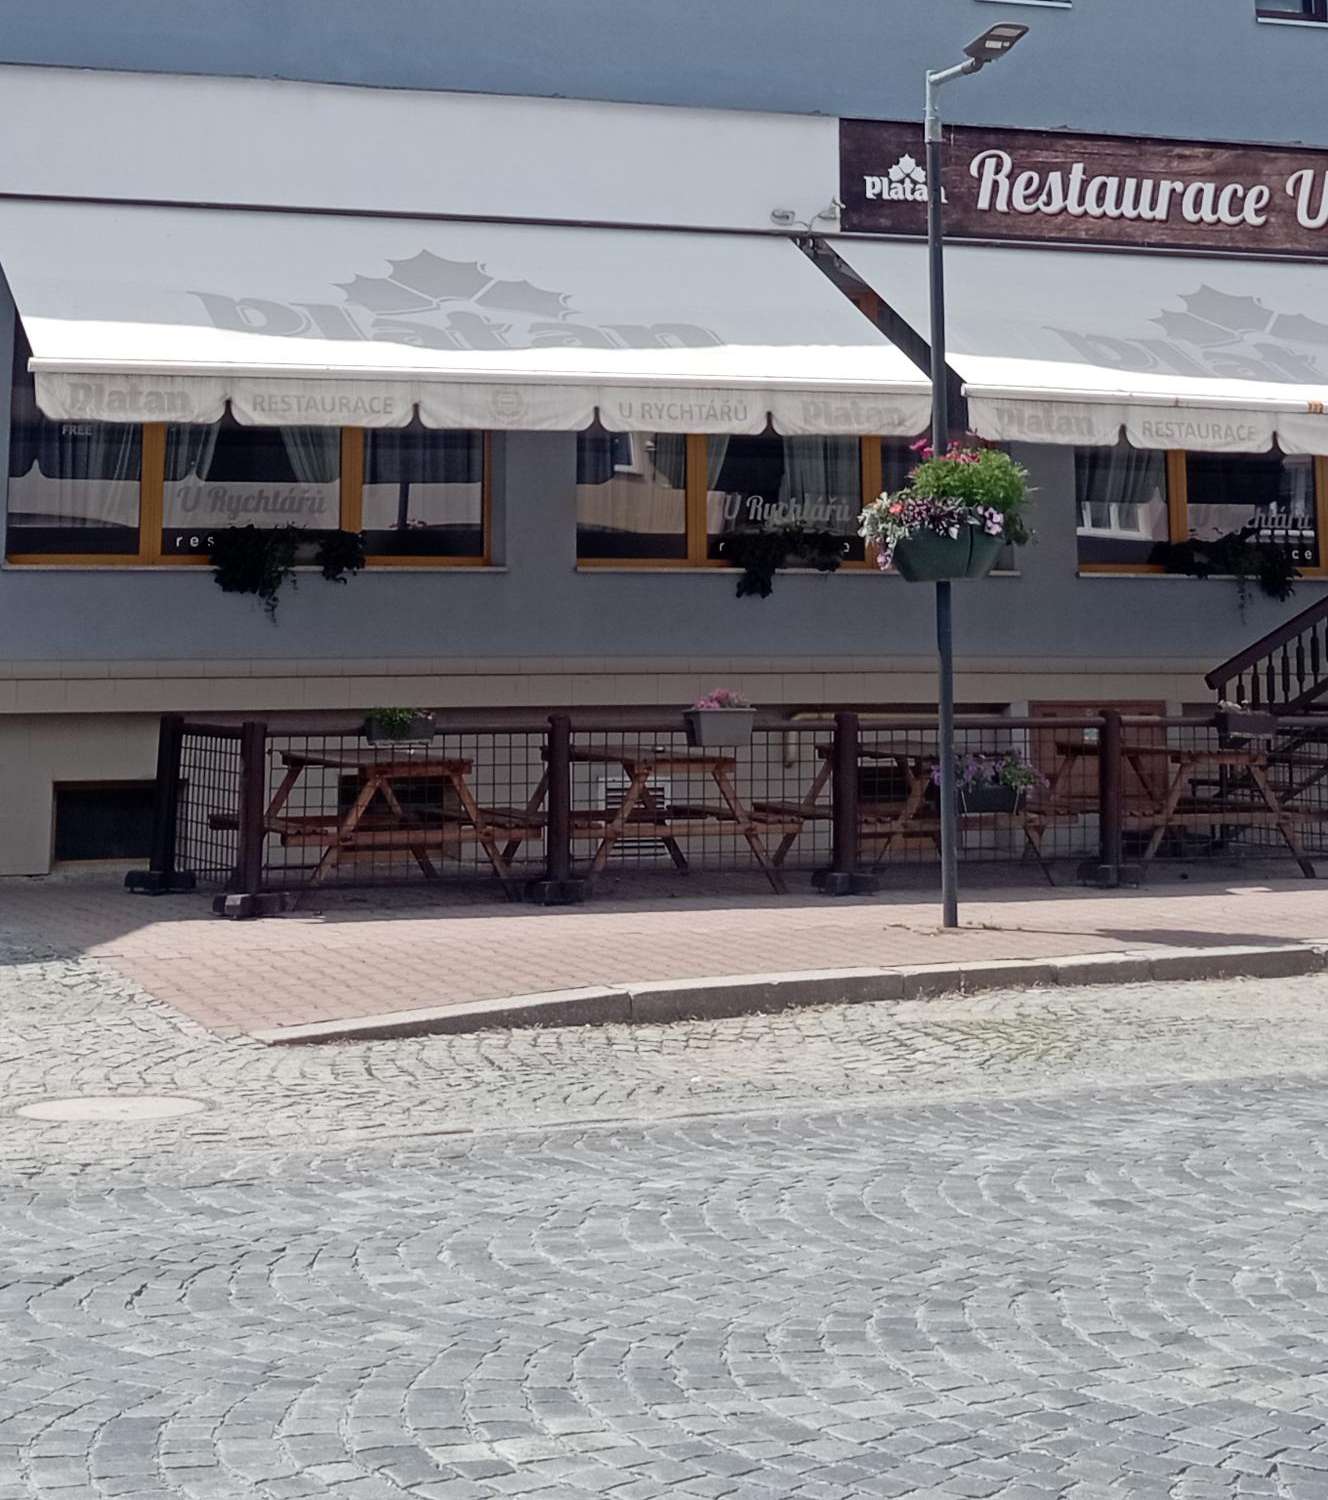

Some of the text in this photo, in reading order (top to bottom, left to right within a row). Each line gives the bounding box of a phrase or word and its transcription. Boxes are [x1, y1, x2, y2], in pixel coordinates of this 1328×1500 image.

[970, 149, 1270, 227] Restaurace
[67, 382, 194, 414] Platan
[252, 394, 394, 415] RESTAURACE
[618, 399, 748, 422] U RYCHTÁŘŮ
[62, 424, 92, 436] FREE
[1142, 419, 1257, 443] RESTAURACE
[177, 486, 201, 513] U
